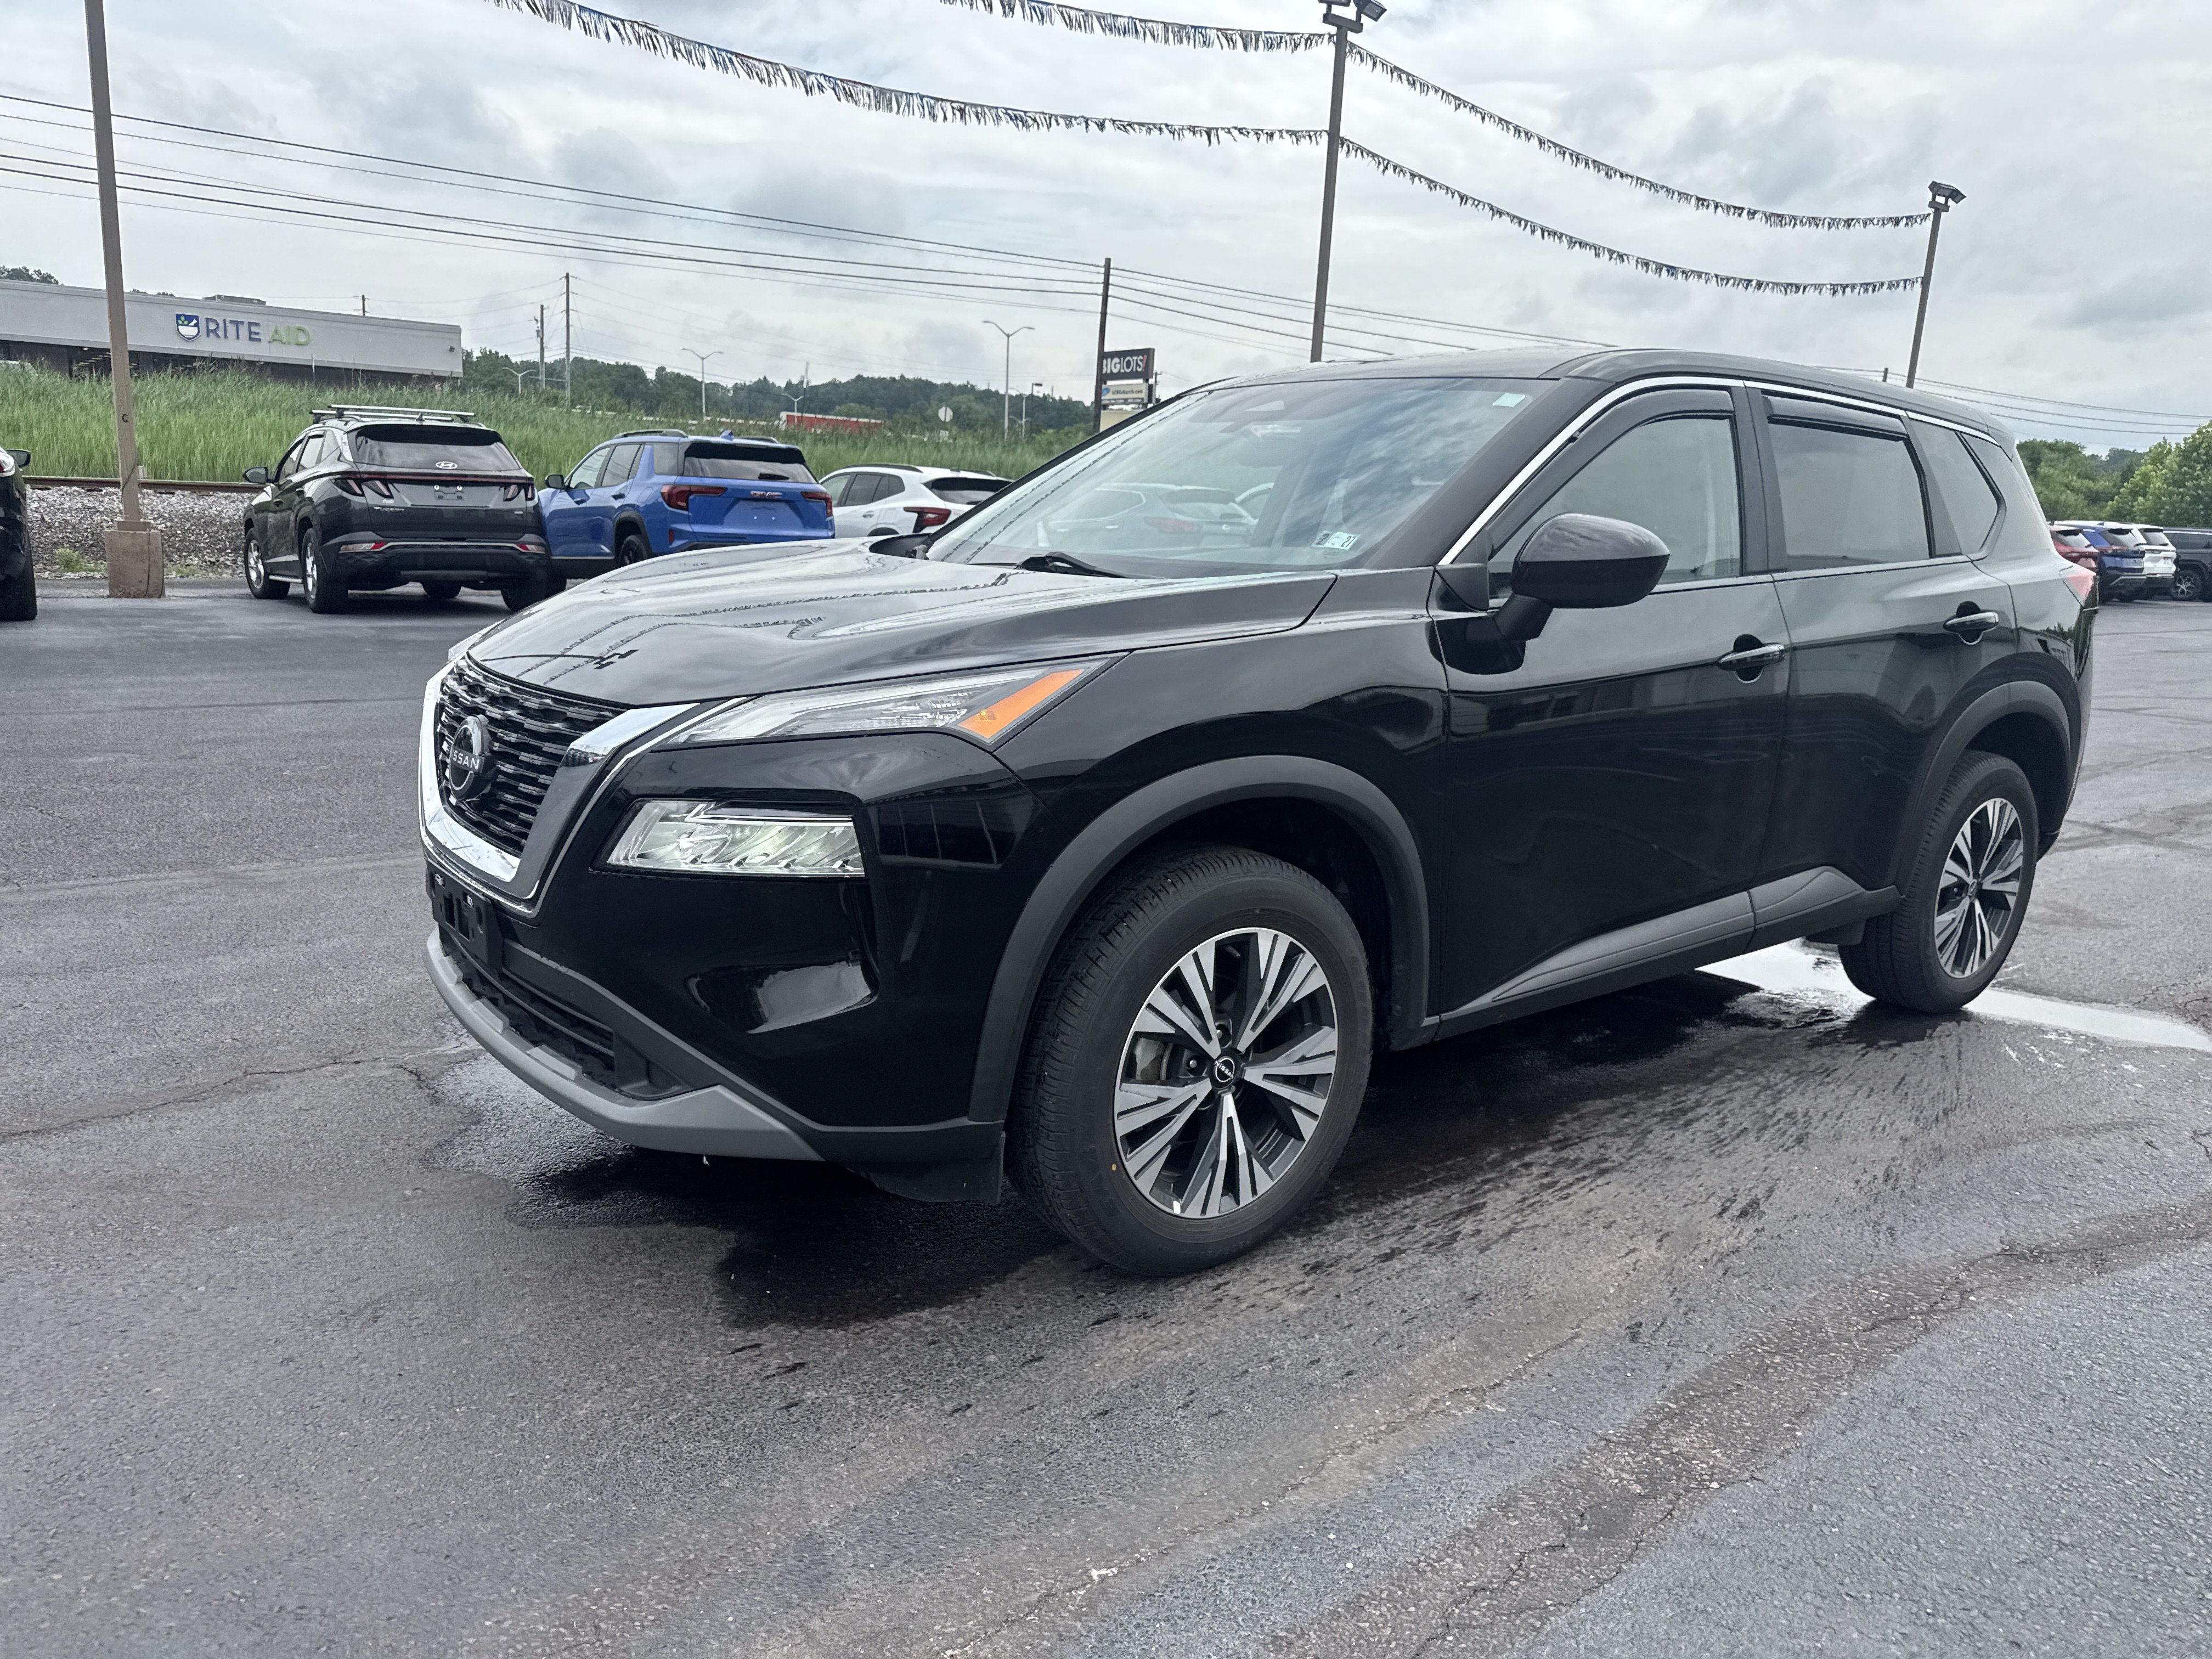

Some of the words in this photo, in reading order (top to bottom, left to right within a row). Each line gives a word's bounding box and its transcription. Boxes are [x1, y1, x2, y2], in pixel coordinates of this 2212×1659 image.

[205, 317, 262, 342] RITE
[268, 325, 309, 345] AID
[750, 490, 782, 499] GMC
[1340, 535, 1356, 548] 27
[453, 749, 479, 770] SSAN
[1214, 1060, 1235, 1079] NISSAN
